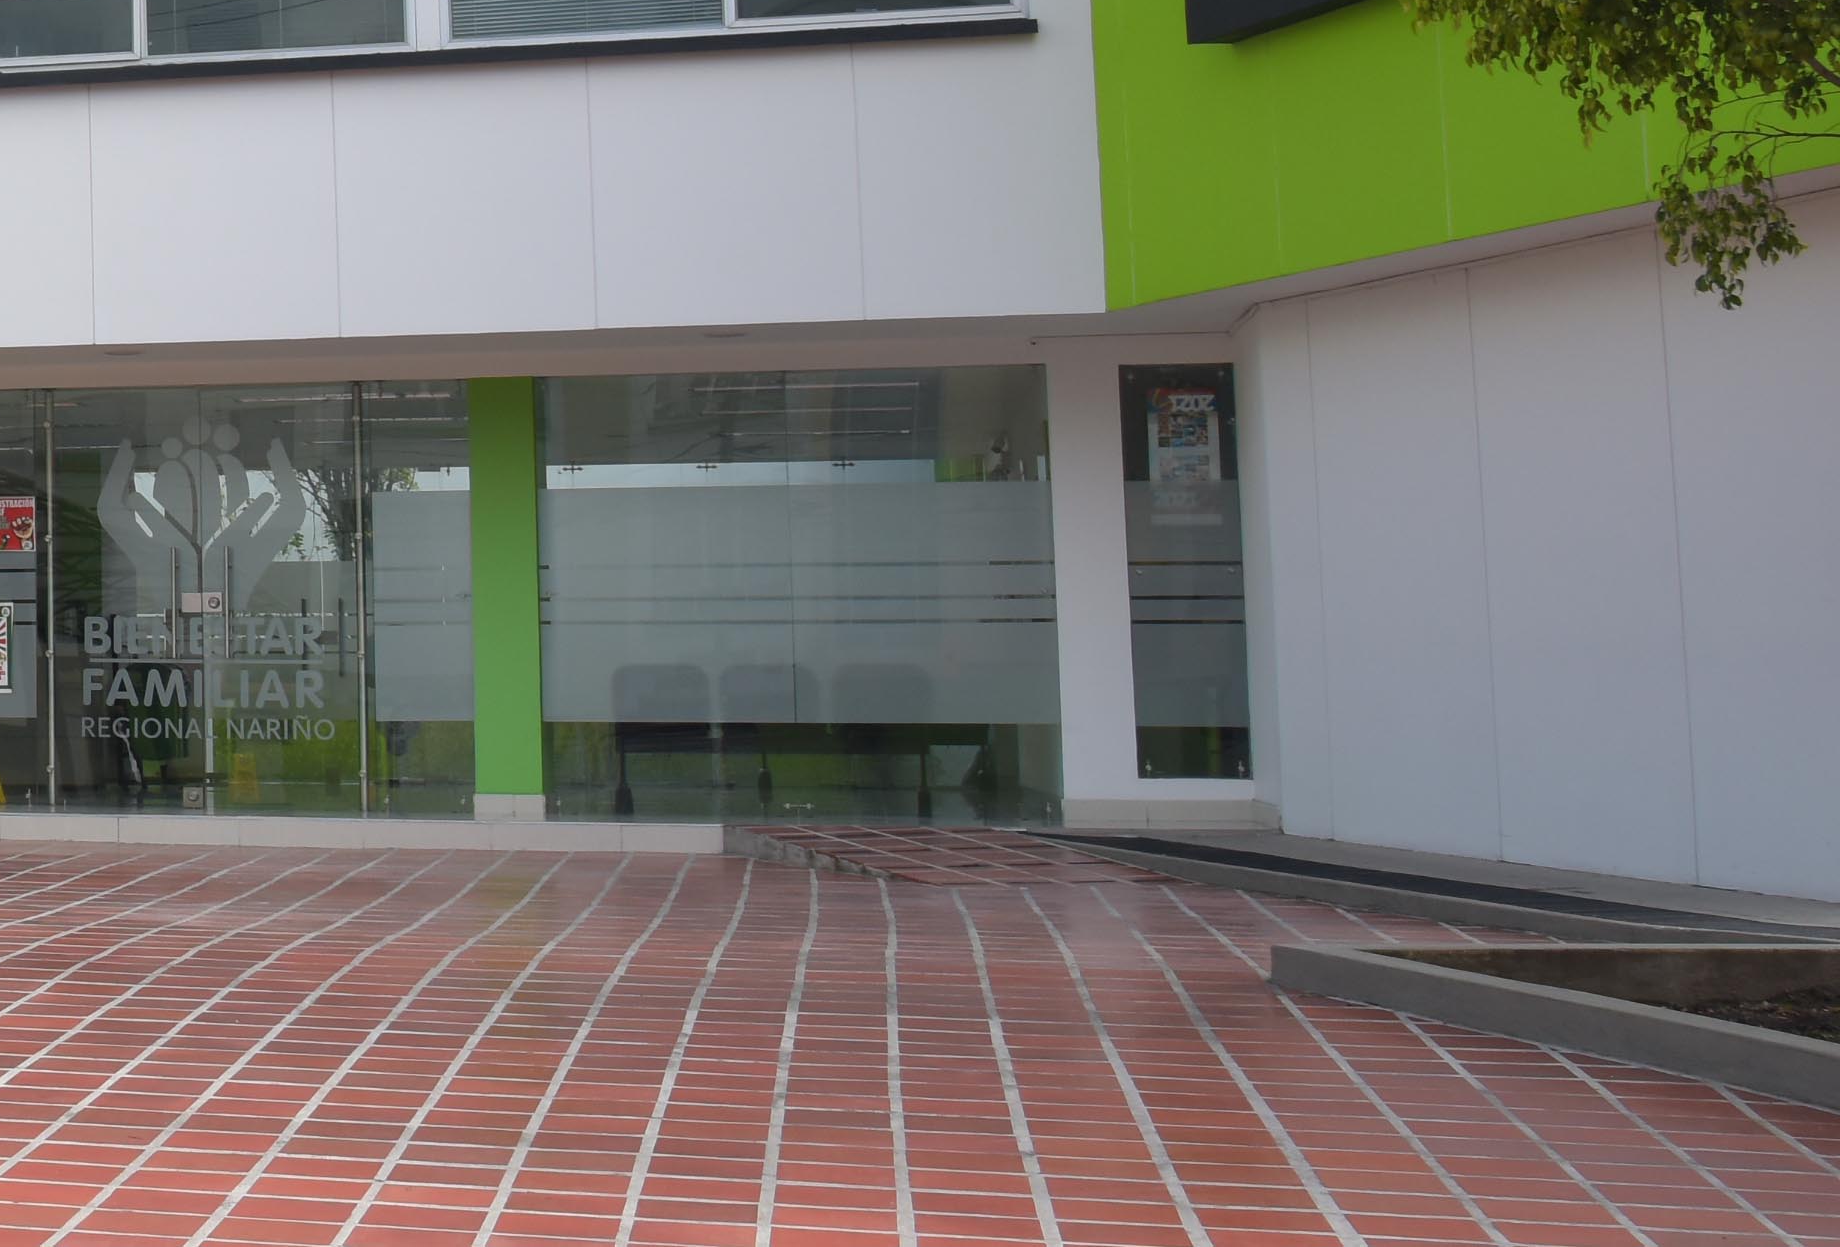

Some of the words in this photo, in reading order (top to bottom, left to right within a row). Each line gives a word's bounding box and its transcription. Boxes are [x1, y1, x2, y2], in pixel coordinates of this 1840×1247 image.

[83, 668, 324, 709] FAMILIAR
[81, 717, 217, 739] REGIONAL
[227, 714, 335, 740] NARIÑO
